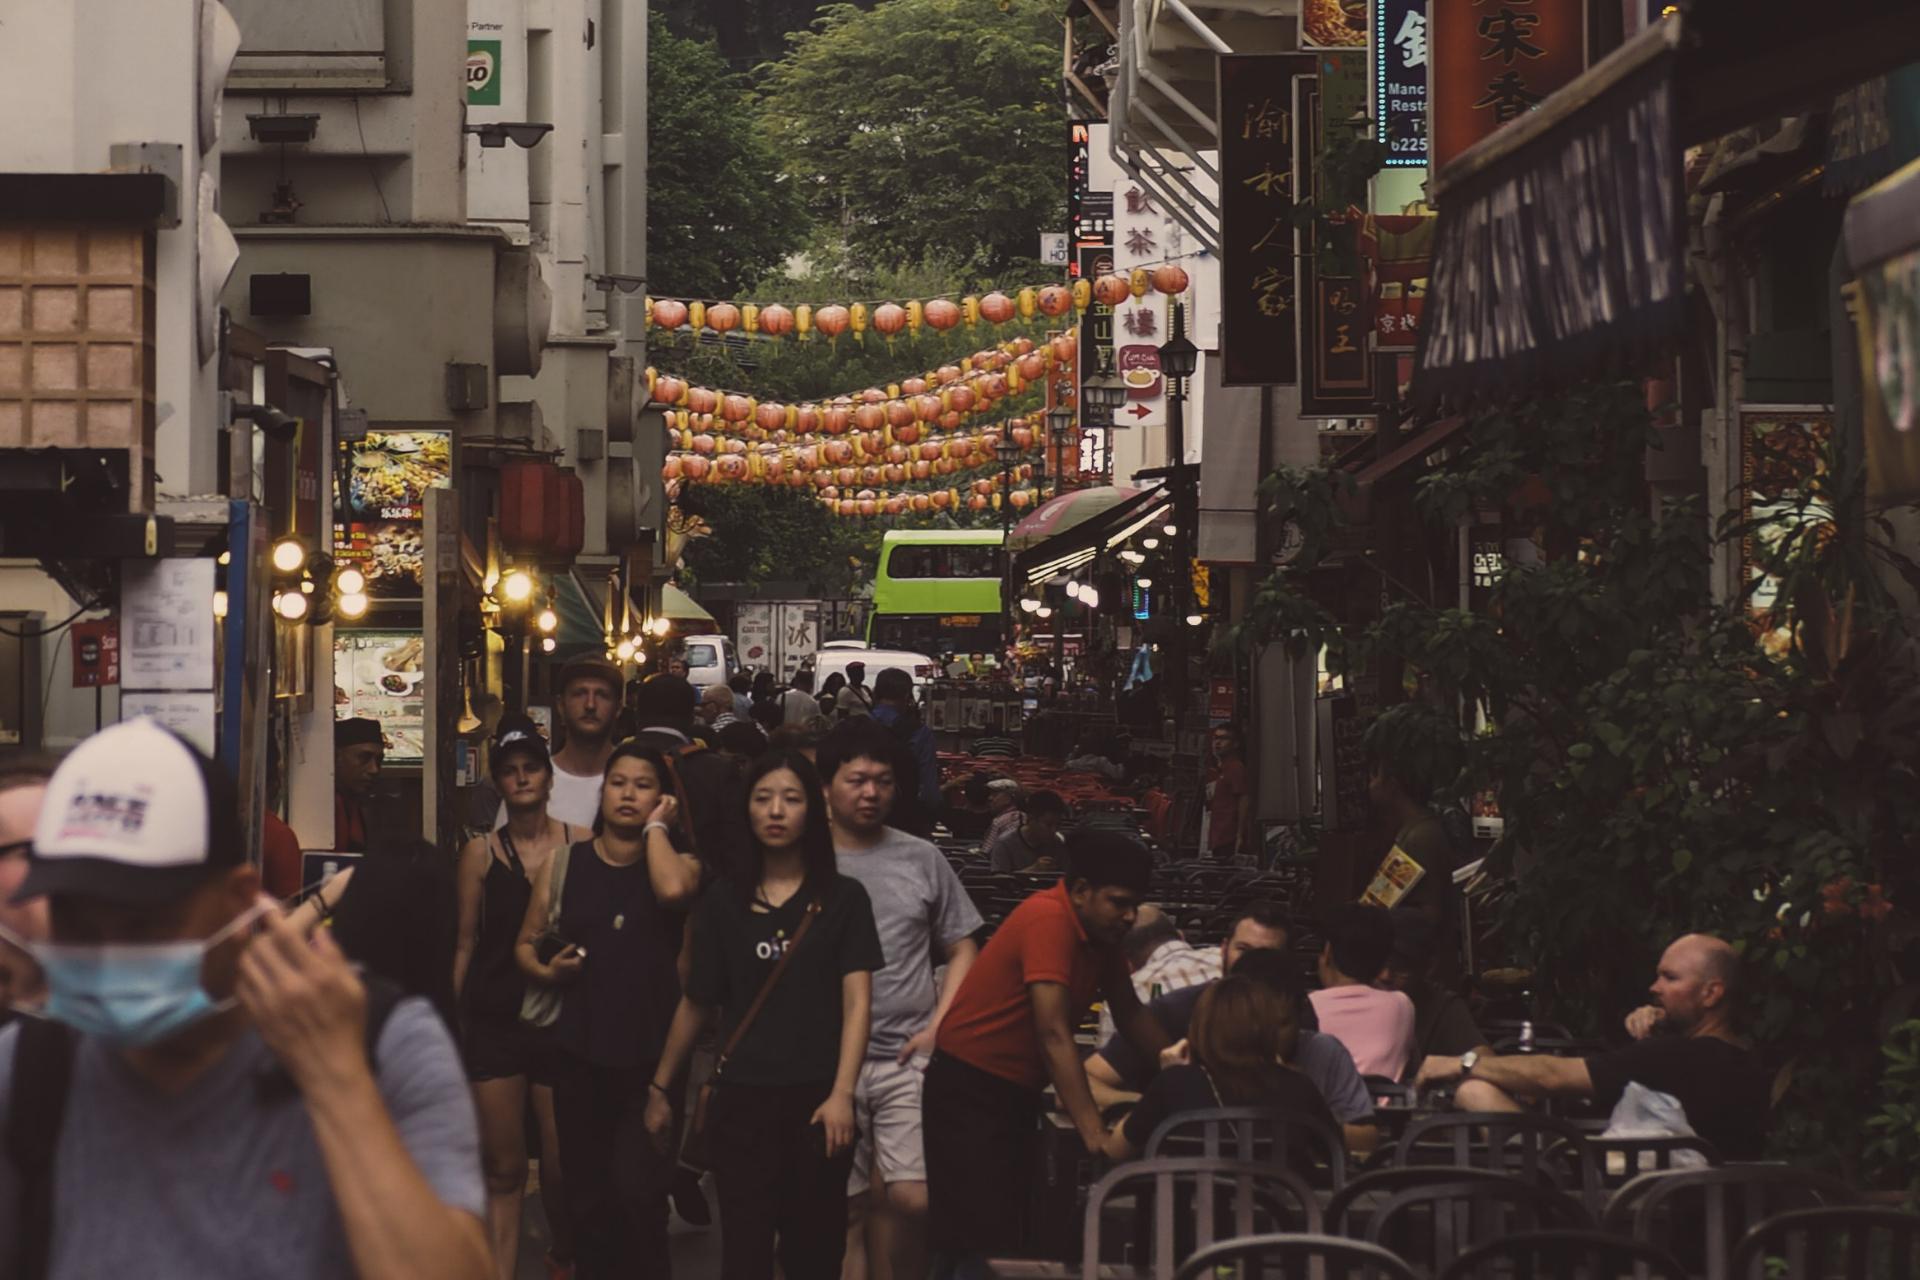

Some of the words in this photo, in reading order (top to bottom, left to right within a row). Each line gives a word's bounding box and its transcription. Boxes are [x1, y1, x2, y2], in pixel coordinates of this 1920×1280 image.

[472, 22, 503, 30] Partner
[1124, 186, 1159, 337] 飲茶樓
[788, 623, 811, 648] 冰
